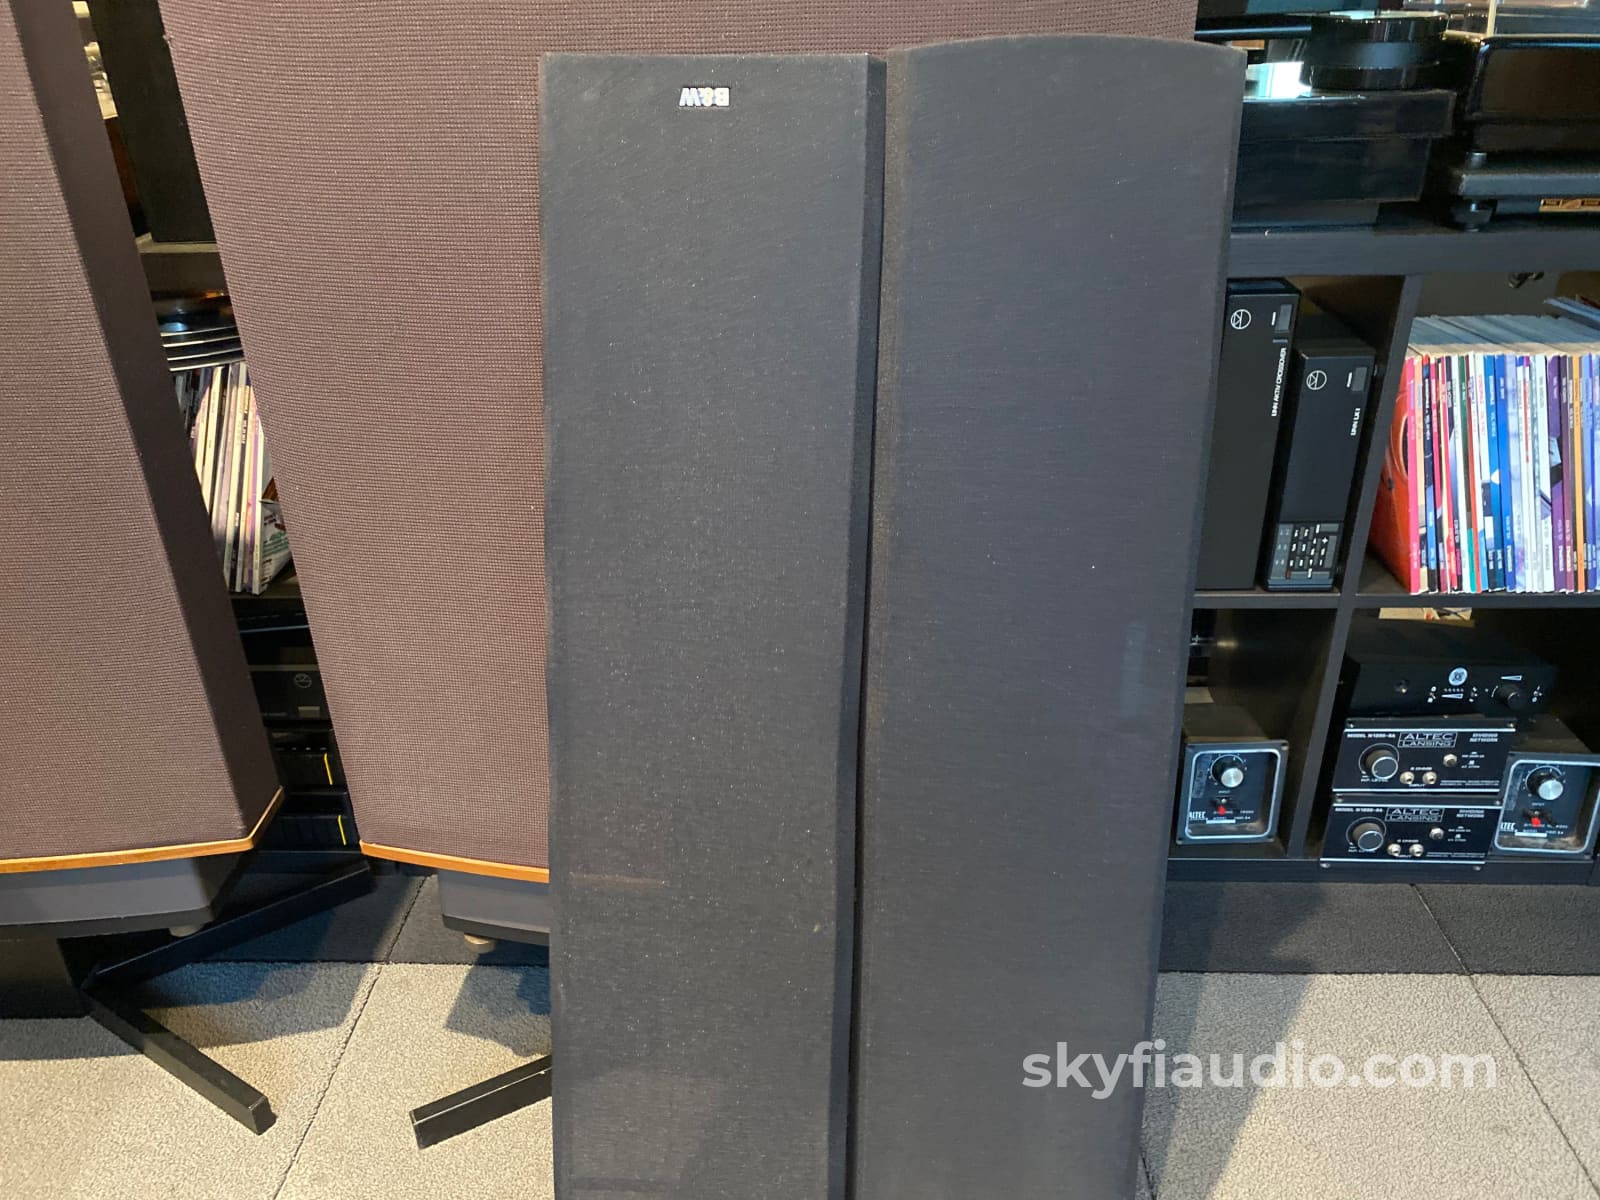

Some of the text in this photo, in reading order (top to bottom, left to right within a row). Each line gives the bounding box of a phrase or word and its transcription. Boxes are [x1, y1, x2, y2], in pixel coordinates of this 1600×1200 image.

[679, 87, 730, 107] B&W
[1271, 402, 1279, 417] LINN
[1350, 421, 1359, 437] LINN
[1404, 732, 1453, 740] ALTEC
[1391, 807, 1441, 815] ALTEC
[1500, 822, 1516, 831] LTEC
